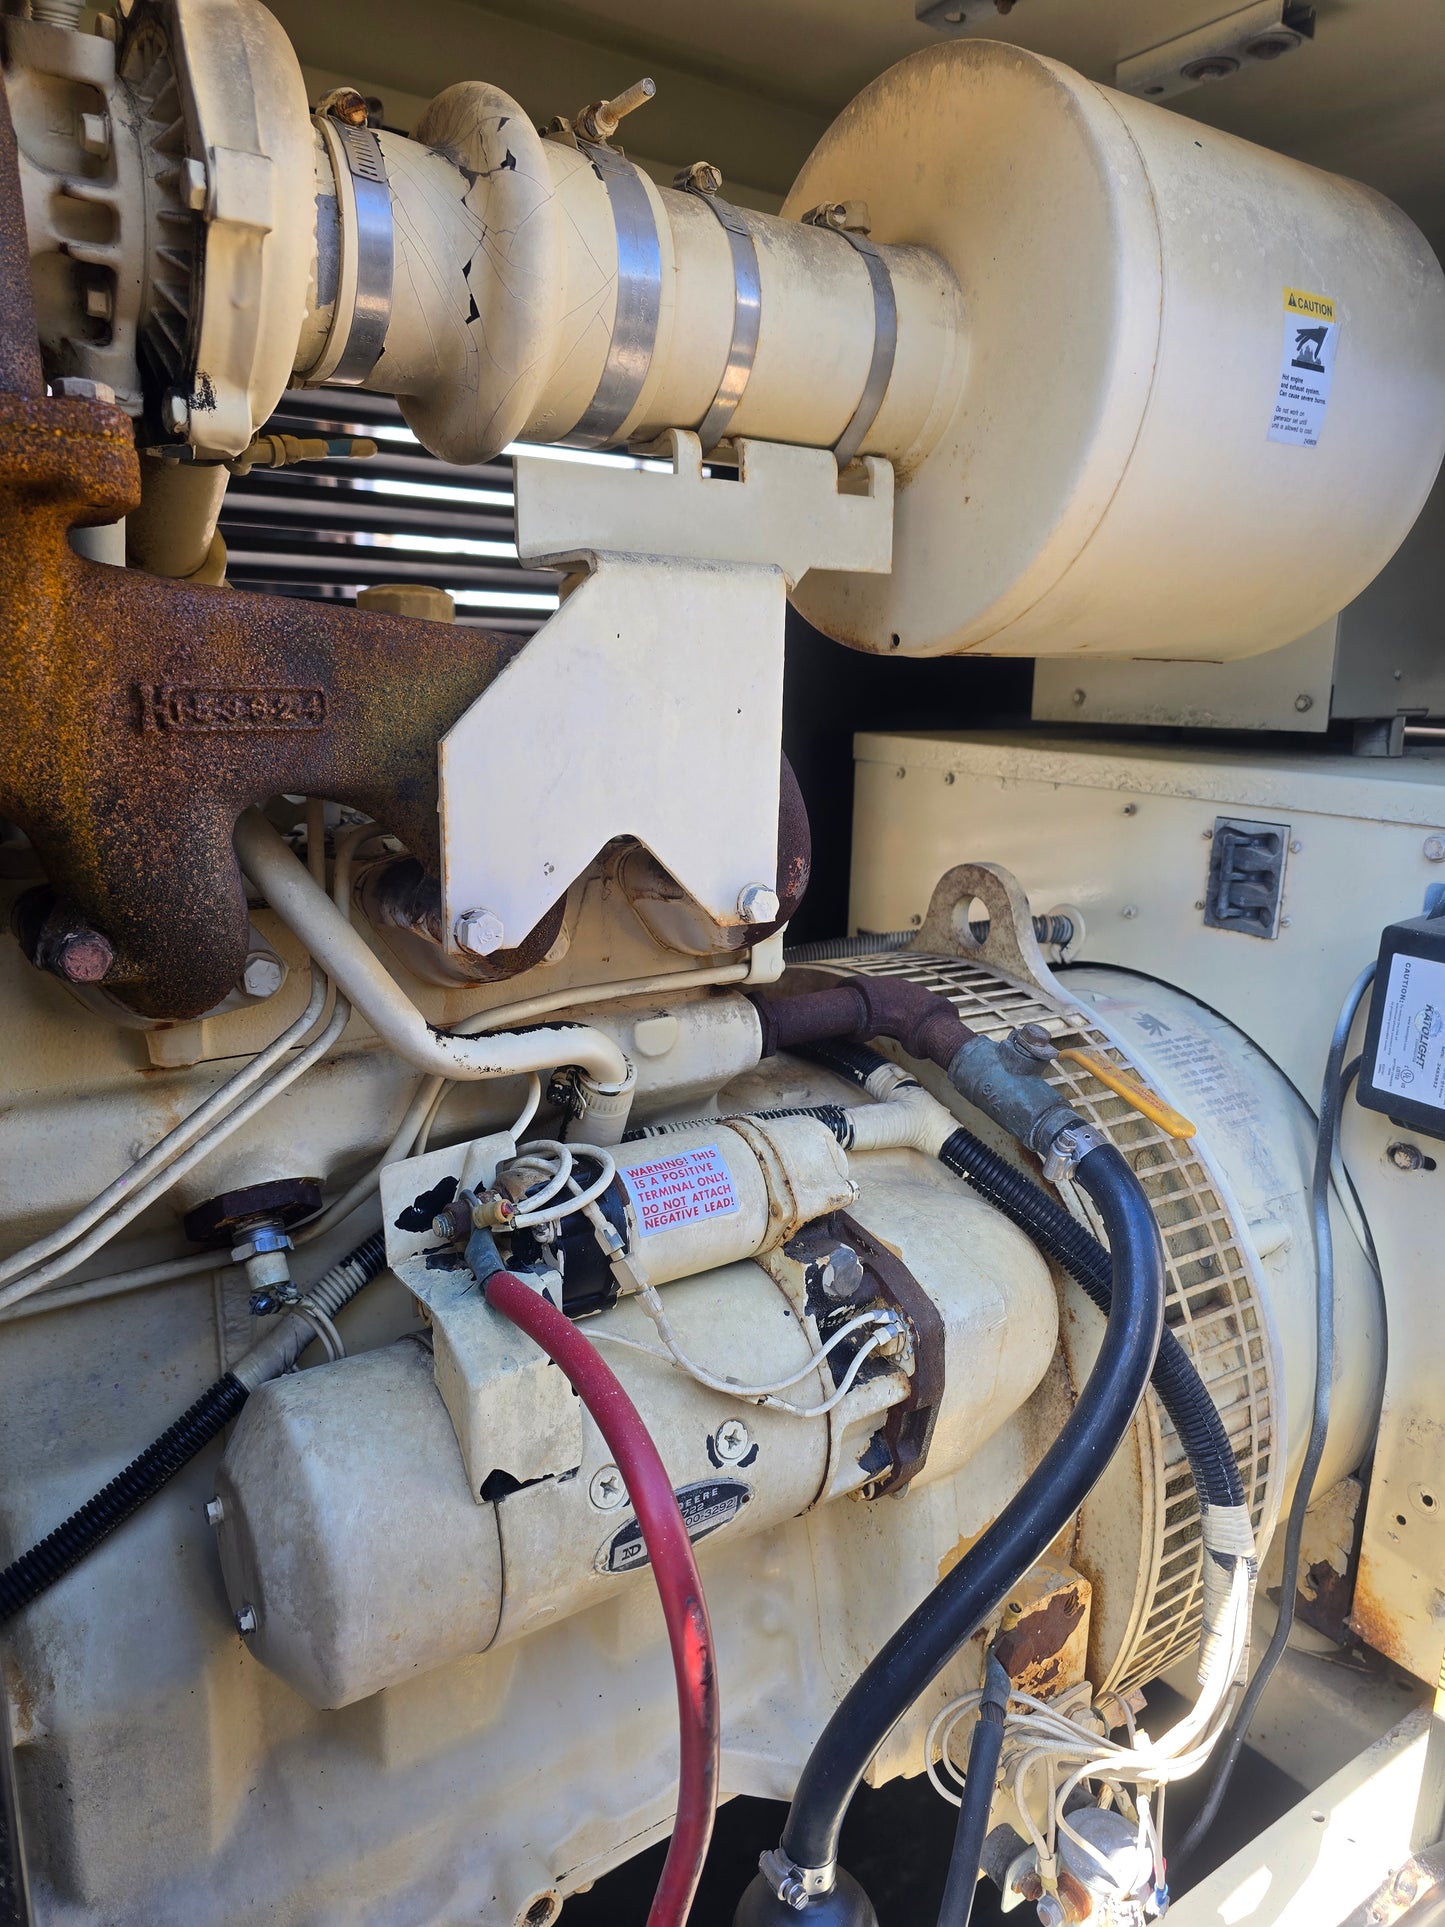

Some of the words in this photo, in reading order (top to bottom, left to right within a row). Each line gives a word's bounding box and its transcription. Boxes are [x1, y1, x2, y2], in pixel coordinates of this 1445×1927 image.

[1297, 297, 1333, 317] CAUTION
[1281, 373, 1290, 381] Hot
[1290, 376, 1304, 384] engine
[1289, 384, 1305, 392] exhaust
[1279, 389, 1288, 397] Can
[1300, 395, 1314, 403] severe
[1398, 962, 1412, 1004] CAUTION:
[626, 1156, 689, 1178] WARNING!
[690, 1149, 716, 1162] THIS
[633, 1180, 646, 1190] IS
[651, 1177, 659, 1186] A
[661, 1162, 713, 1182] POSITIVE
[638, 1180, 695, 1202] TERMINAL
[697, 1171, 728, 1187] ONLY.
[642, 1203, 659, 1217] DO
[663, 1196, 687, 1211] NOT
[692, 1183, 732, 1203] ATTACH
[644, 1206, 699, 1230] NEGATIVE
[704, 1196, 735, 1213] LEAD!
[685, 1499, 735, 1526] 00-3292
